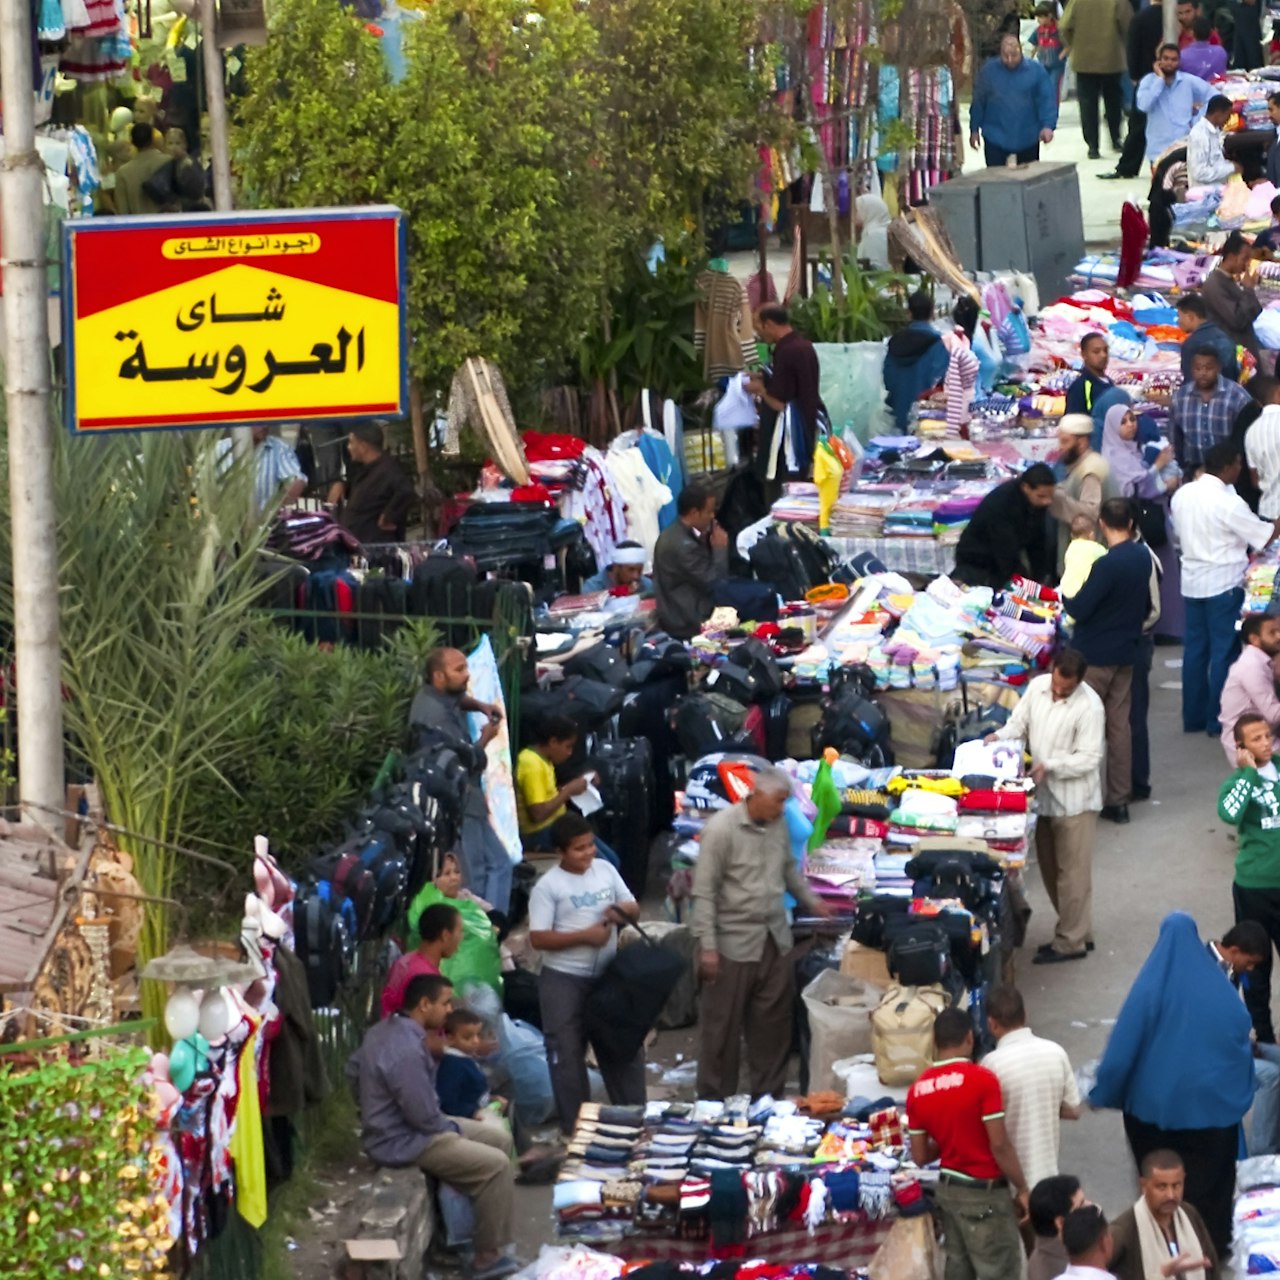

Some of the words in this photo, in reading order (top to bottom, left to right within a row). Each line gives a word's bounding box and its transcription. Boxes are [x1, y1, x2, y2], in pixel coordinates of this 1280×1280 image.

[228, 236, 270, 254] أنواع
[176, 287, 286, 332] شاى
[114, 325, 366, 395] العروسة
